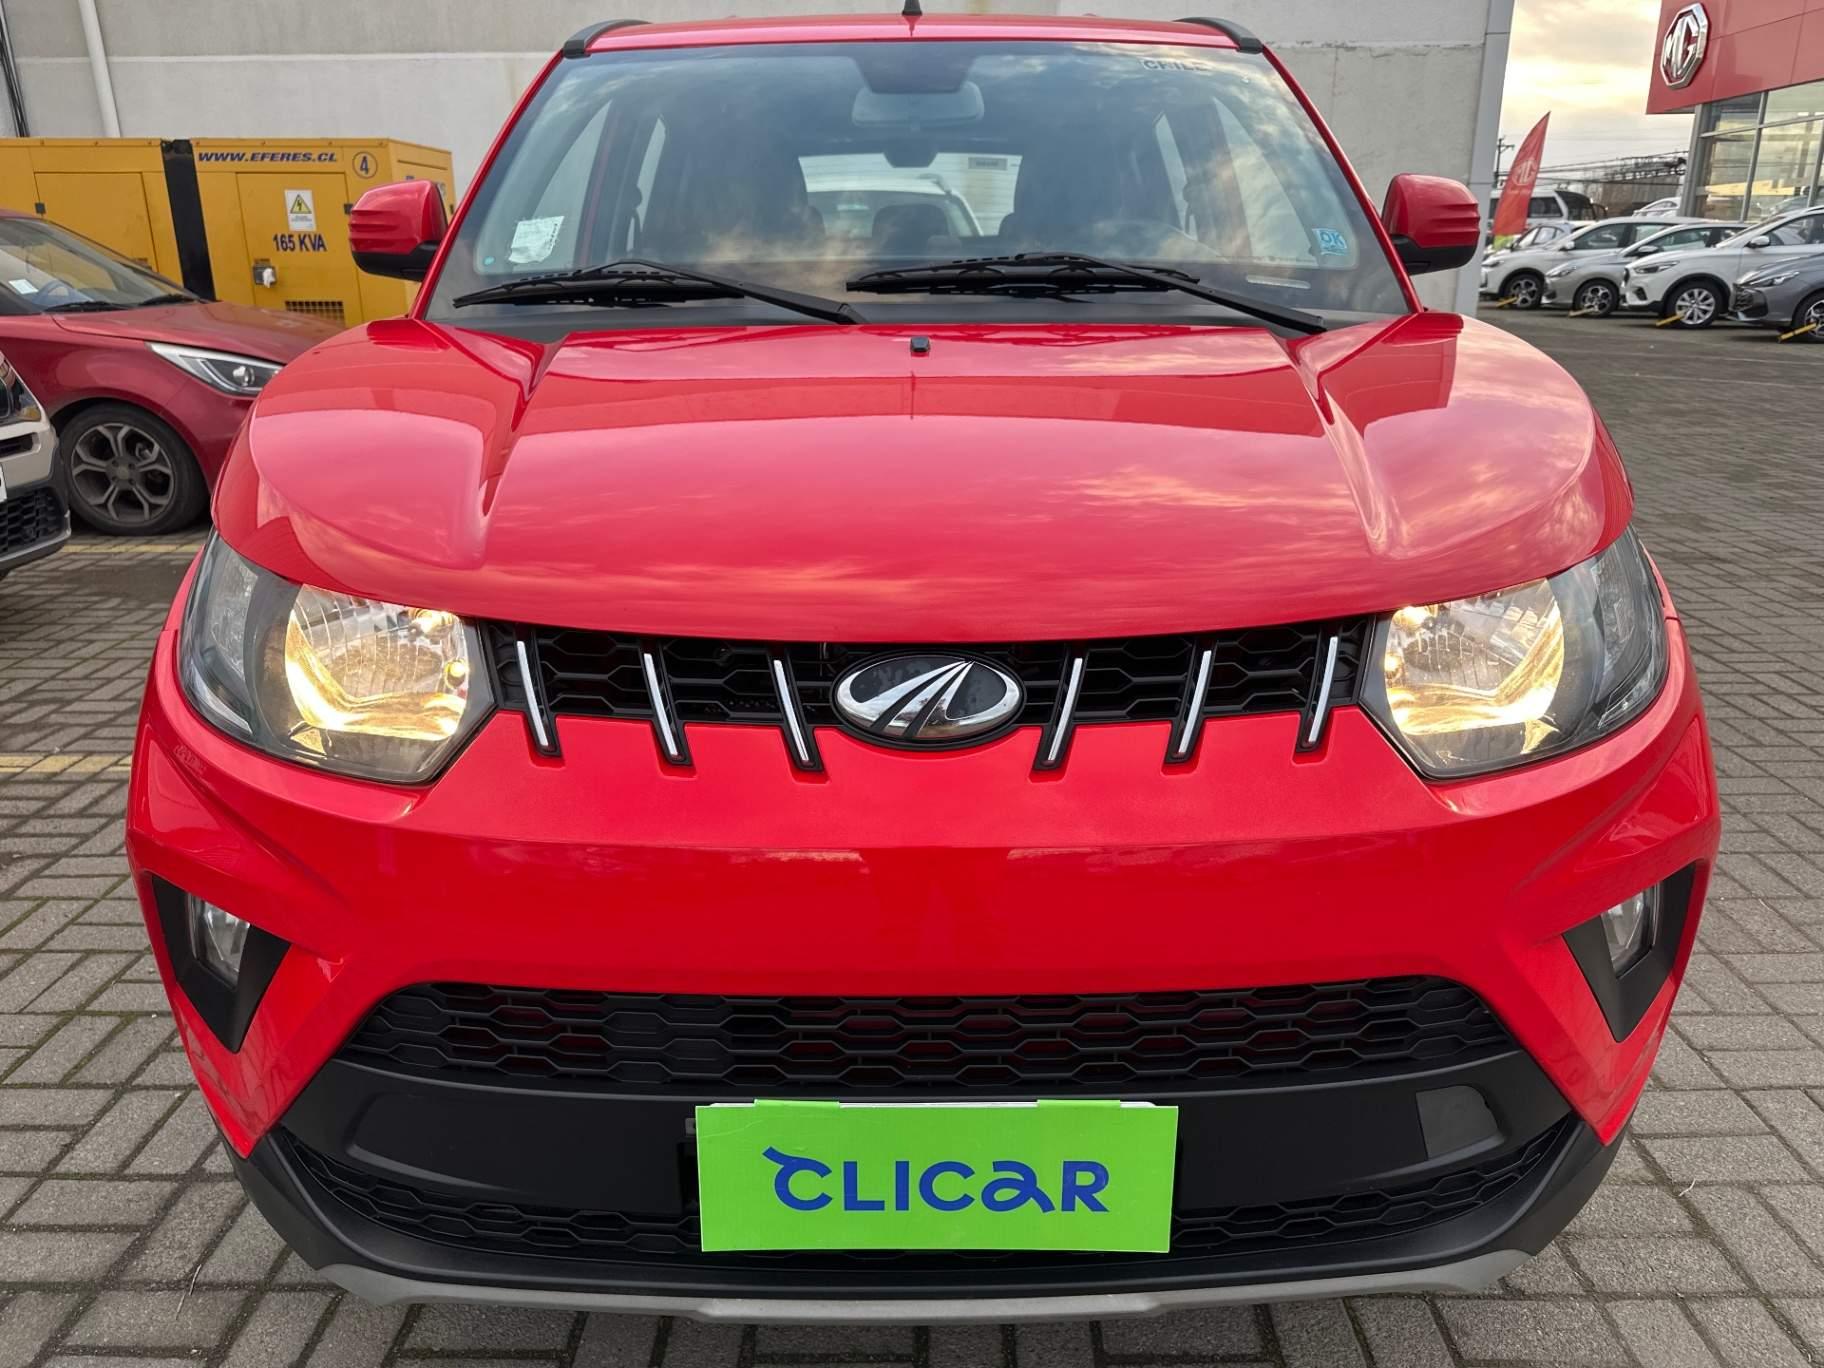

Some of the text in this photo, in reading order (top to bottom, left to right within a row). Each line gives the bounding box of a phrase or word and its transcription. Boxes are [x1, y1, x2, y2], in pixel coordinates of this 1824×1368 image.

[1663, 13, 1700, 79] MG
[198, 152, 338, 163] WWW.EFERES.CL
[359, 155, 370, 175] 4
[273, 233, 328, 252] 165 KVA
